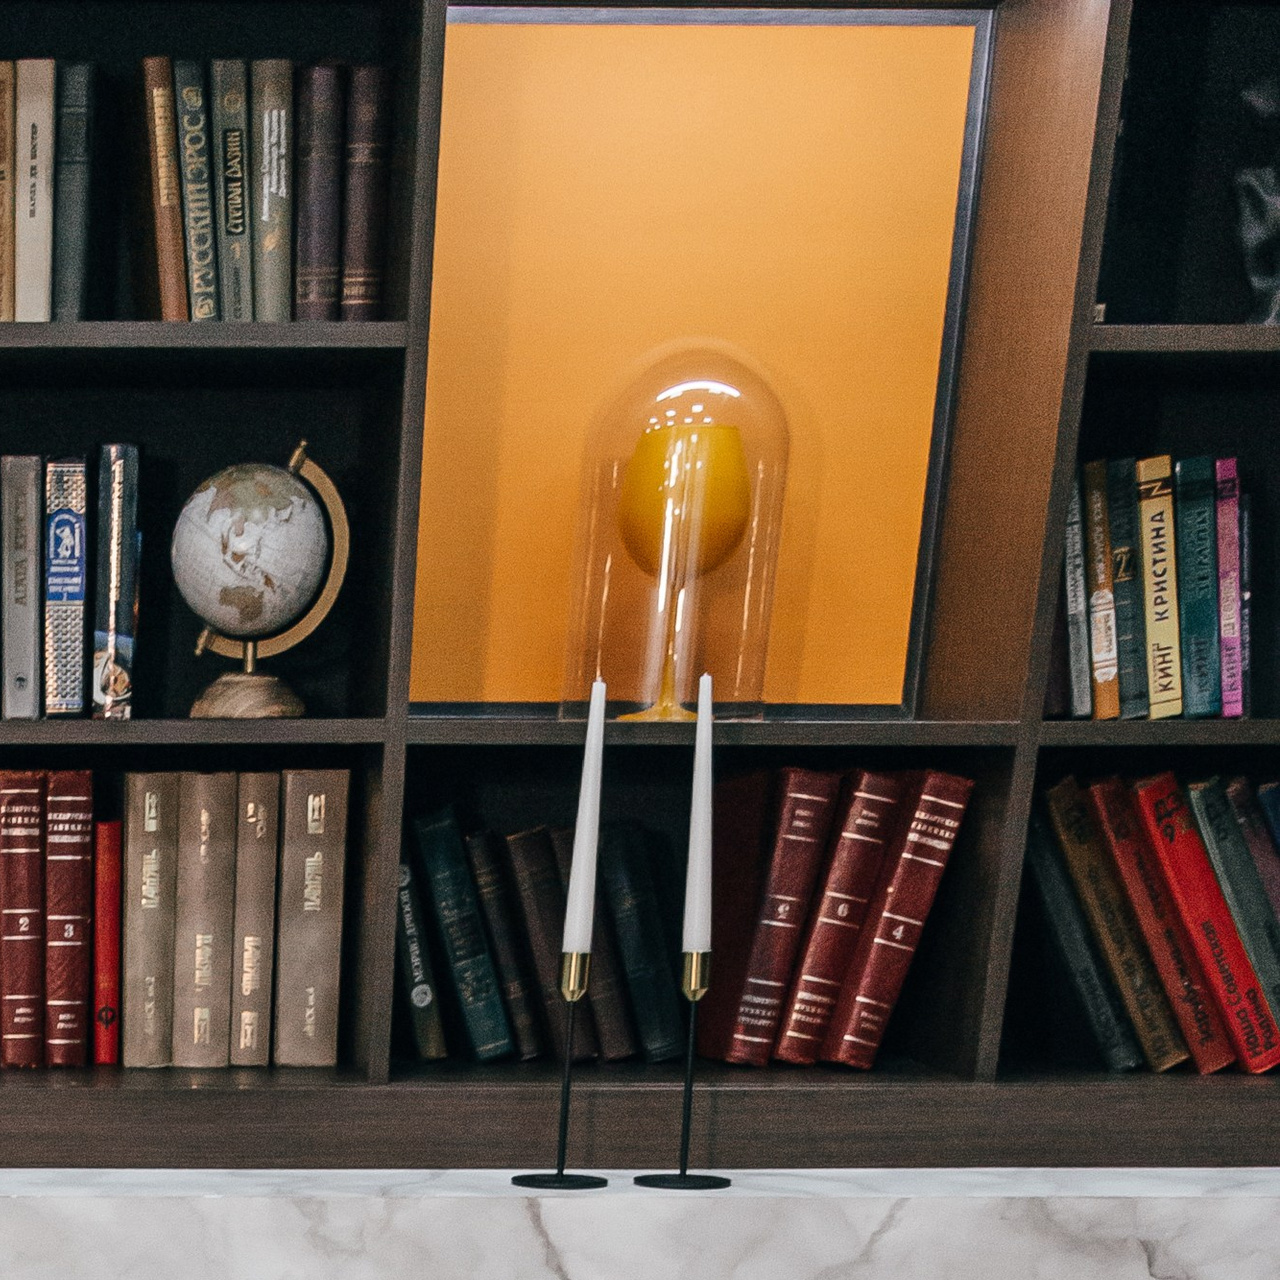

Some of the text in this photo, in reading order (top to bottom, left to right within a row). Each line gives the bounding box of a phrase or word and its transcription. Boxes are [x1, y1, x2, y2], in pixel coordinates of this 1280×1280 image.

[182, 113, 215, 294] РУССКИЙ ЭРОС
[1150, 510, 1174, 694] КИНГ КРИСТИНА
[19, 917, 30, 932] 2
[64, 923, 74, 938] 3
[892, 925, 904, 941] 4
[408, 938, 425, 984] МОРИС
[1202, 918, 1243, 1007] Советская
